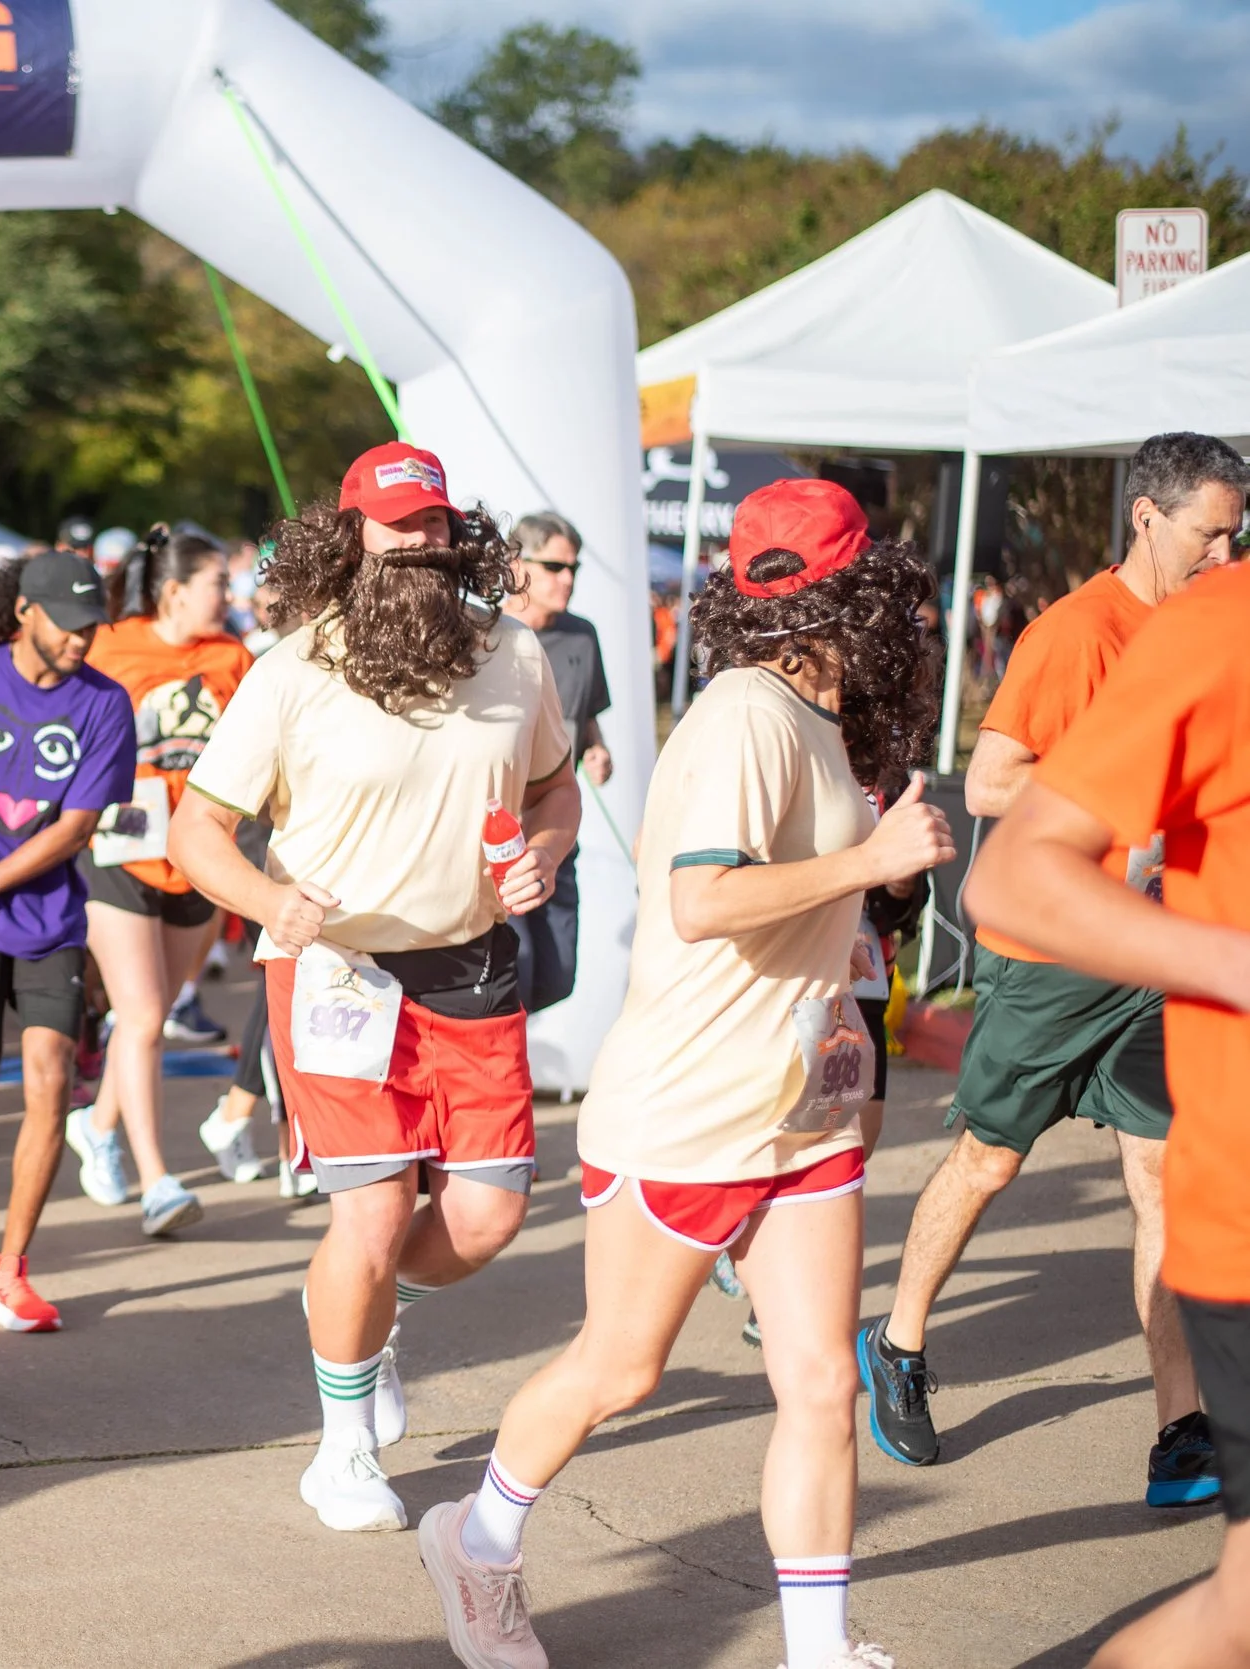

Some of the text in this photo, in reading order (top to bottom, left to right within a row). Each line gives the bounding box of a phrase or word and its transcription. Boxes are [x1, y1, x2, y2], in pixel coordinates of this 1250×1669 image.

[1145, 223, 1177, 246] NO
[1125, 250, 1199, 274] PARKING
[309, 1004, 371, 1042] 907
[820, 1047, 862, 1095] 908
[456, 1575, 478, 1624] HOKA
